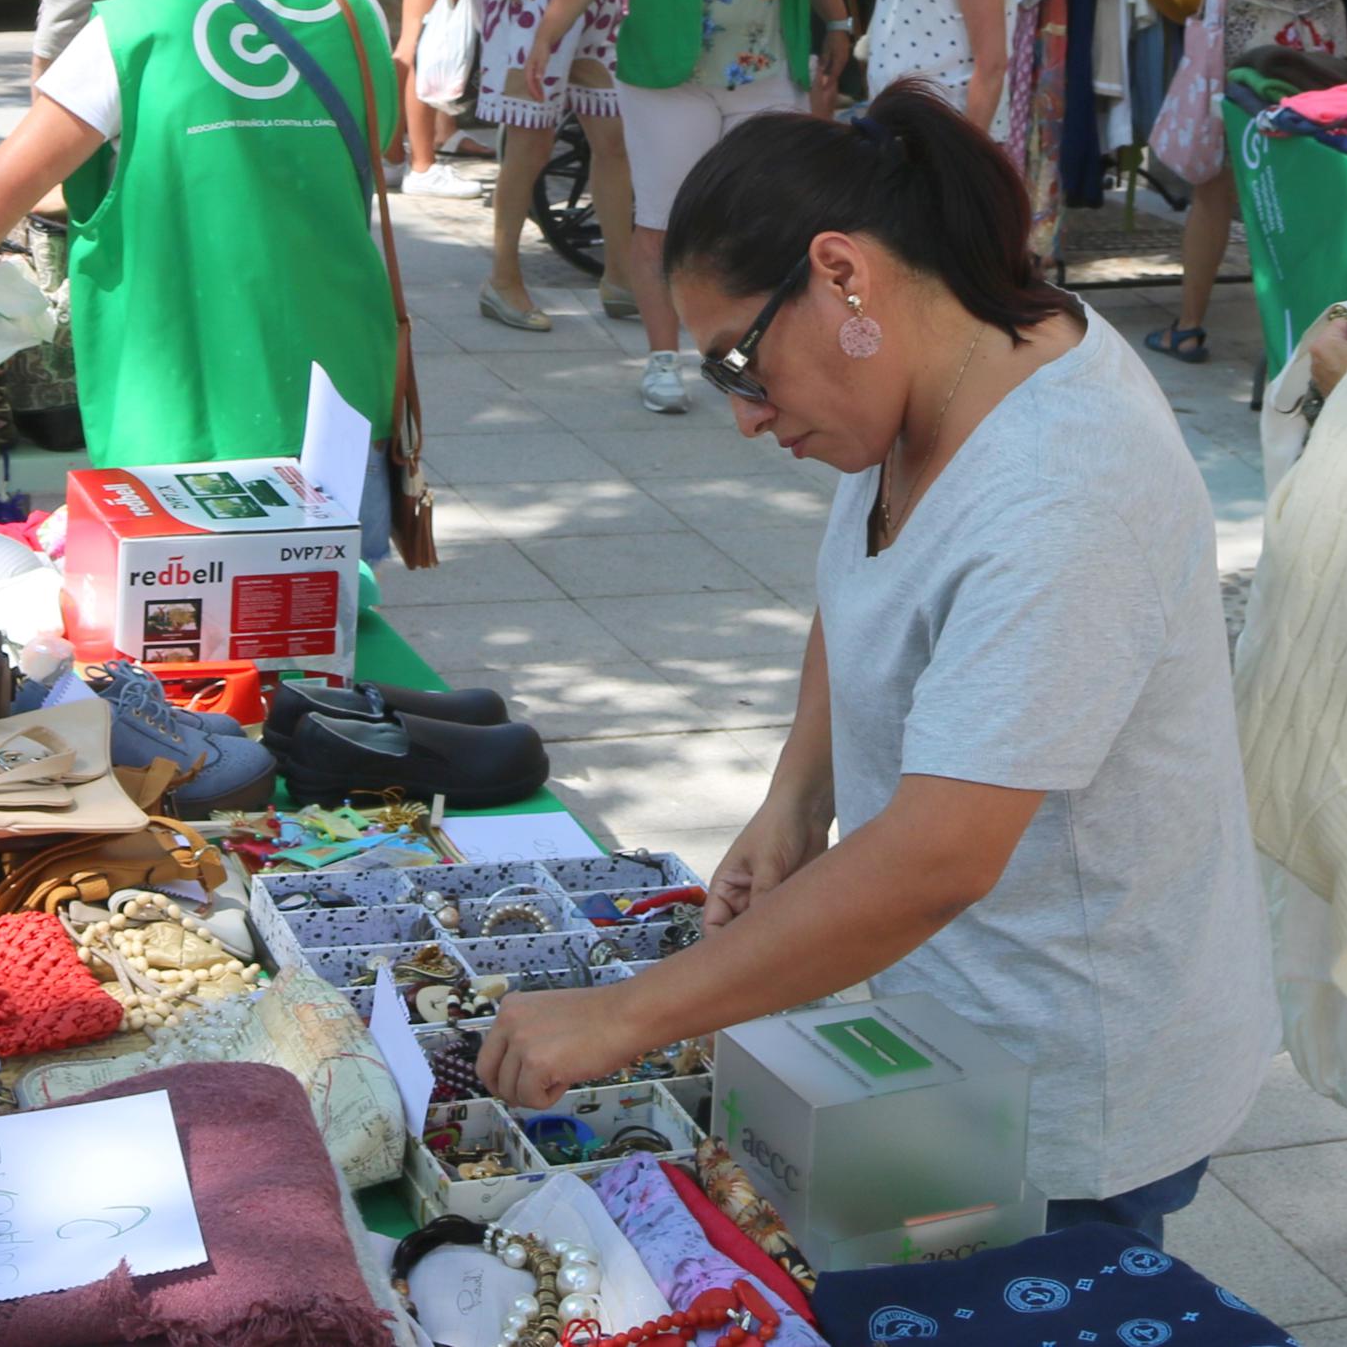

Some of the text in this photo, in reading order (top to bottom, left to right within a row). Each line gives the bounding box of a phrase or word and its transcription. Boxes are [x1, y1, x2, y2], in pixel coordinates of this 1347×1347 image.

[102, 483, 154, 518] redbell
[280, 544, 346, 562] DVP72X
[129, 556, 224, 587] redbell
[741, 1127, 799, 1192] aecc
